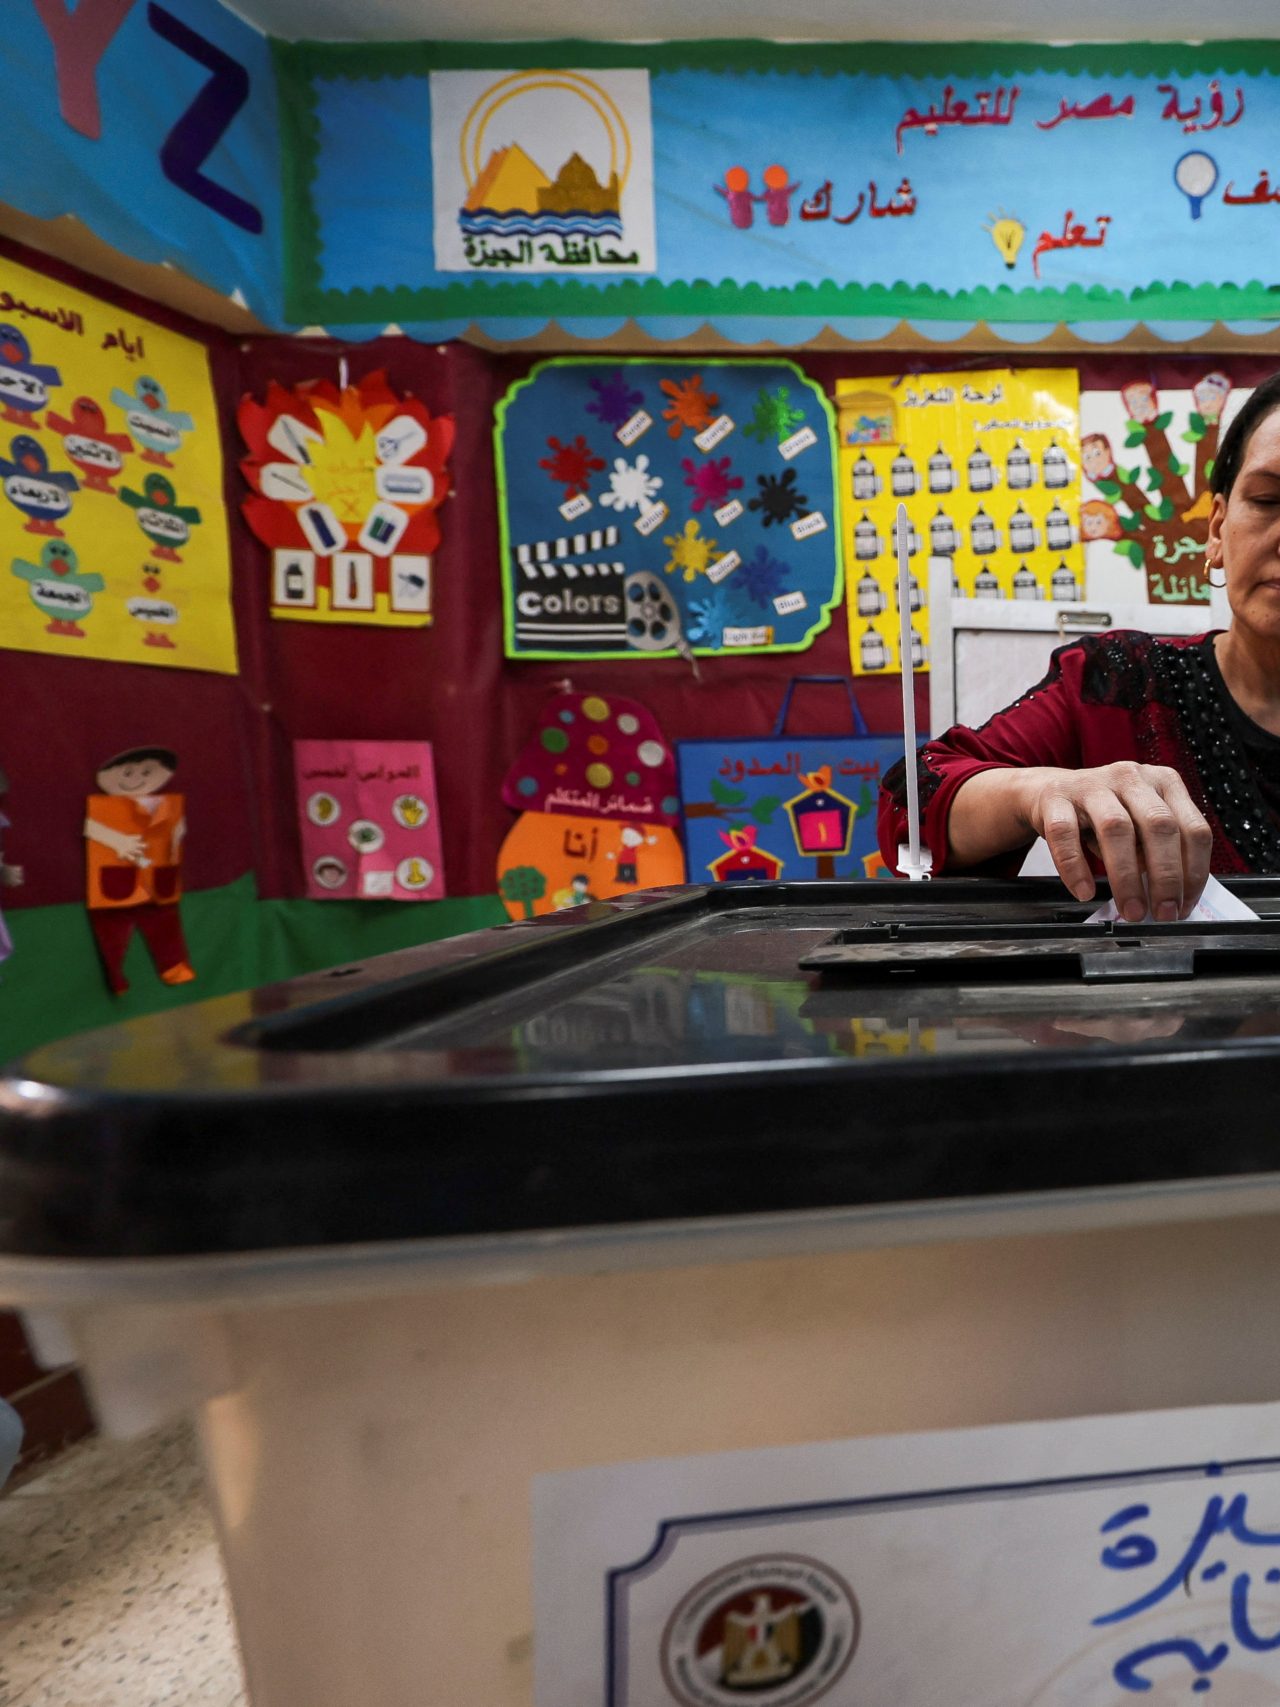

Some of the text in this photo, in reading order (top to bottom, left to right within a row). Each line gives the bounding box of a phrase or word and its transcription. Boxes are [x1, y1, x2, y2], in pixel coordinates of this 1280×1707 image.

[147, 0, 265, 236] Z
[895, 81, 1246, 154] رؤية مصر للتعليم
[799, 177, 918, 225] شارك
[462, 233, 639, 267] محافظة الجيزة
[1032, 210, 1112, 280] تعلم
[0, 292, 84, 336] الاسبو
[516, 587, 620, 617] Colors
